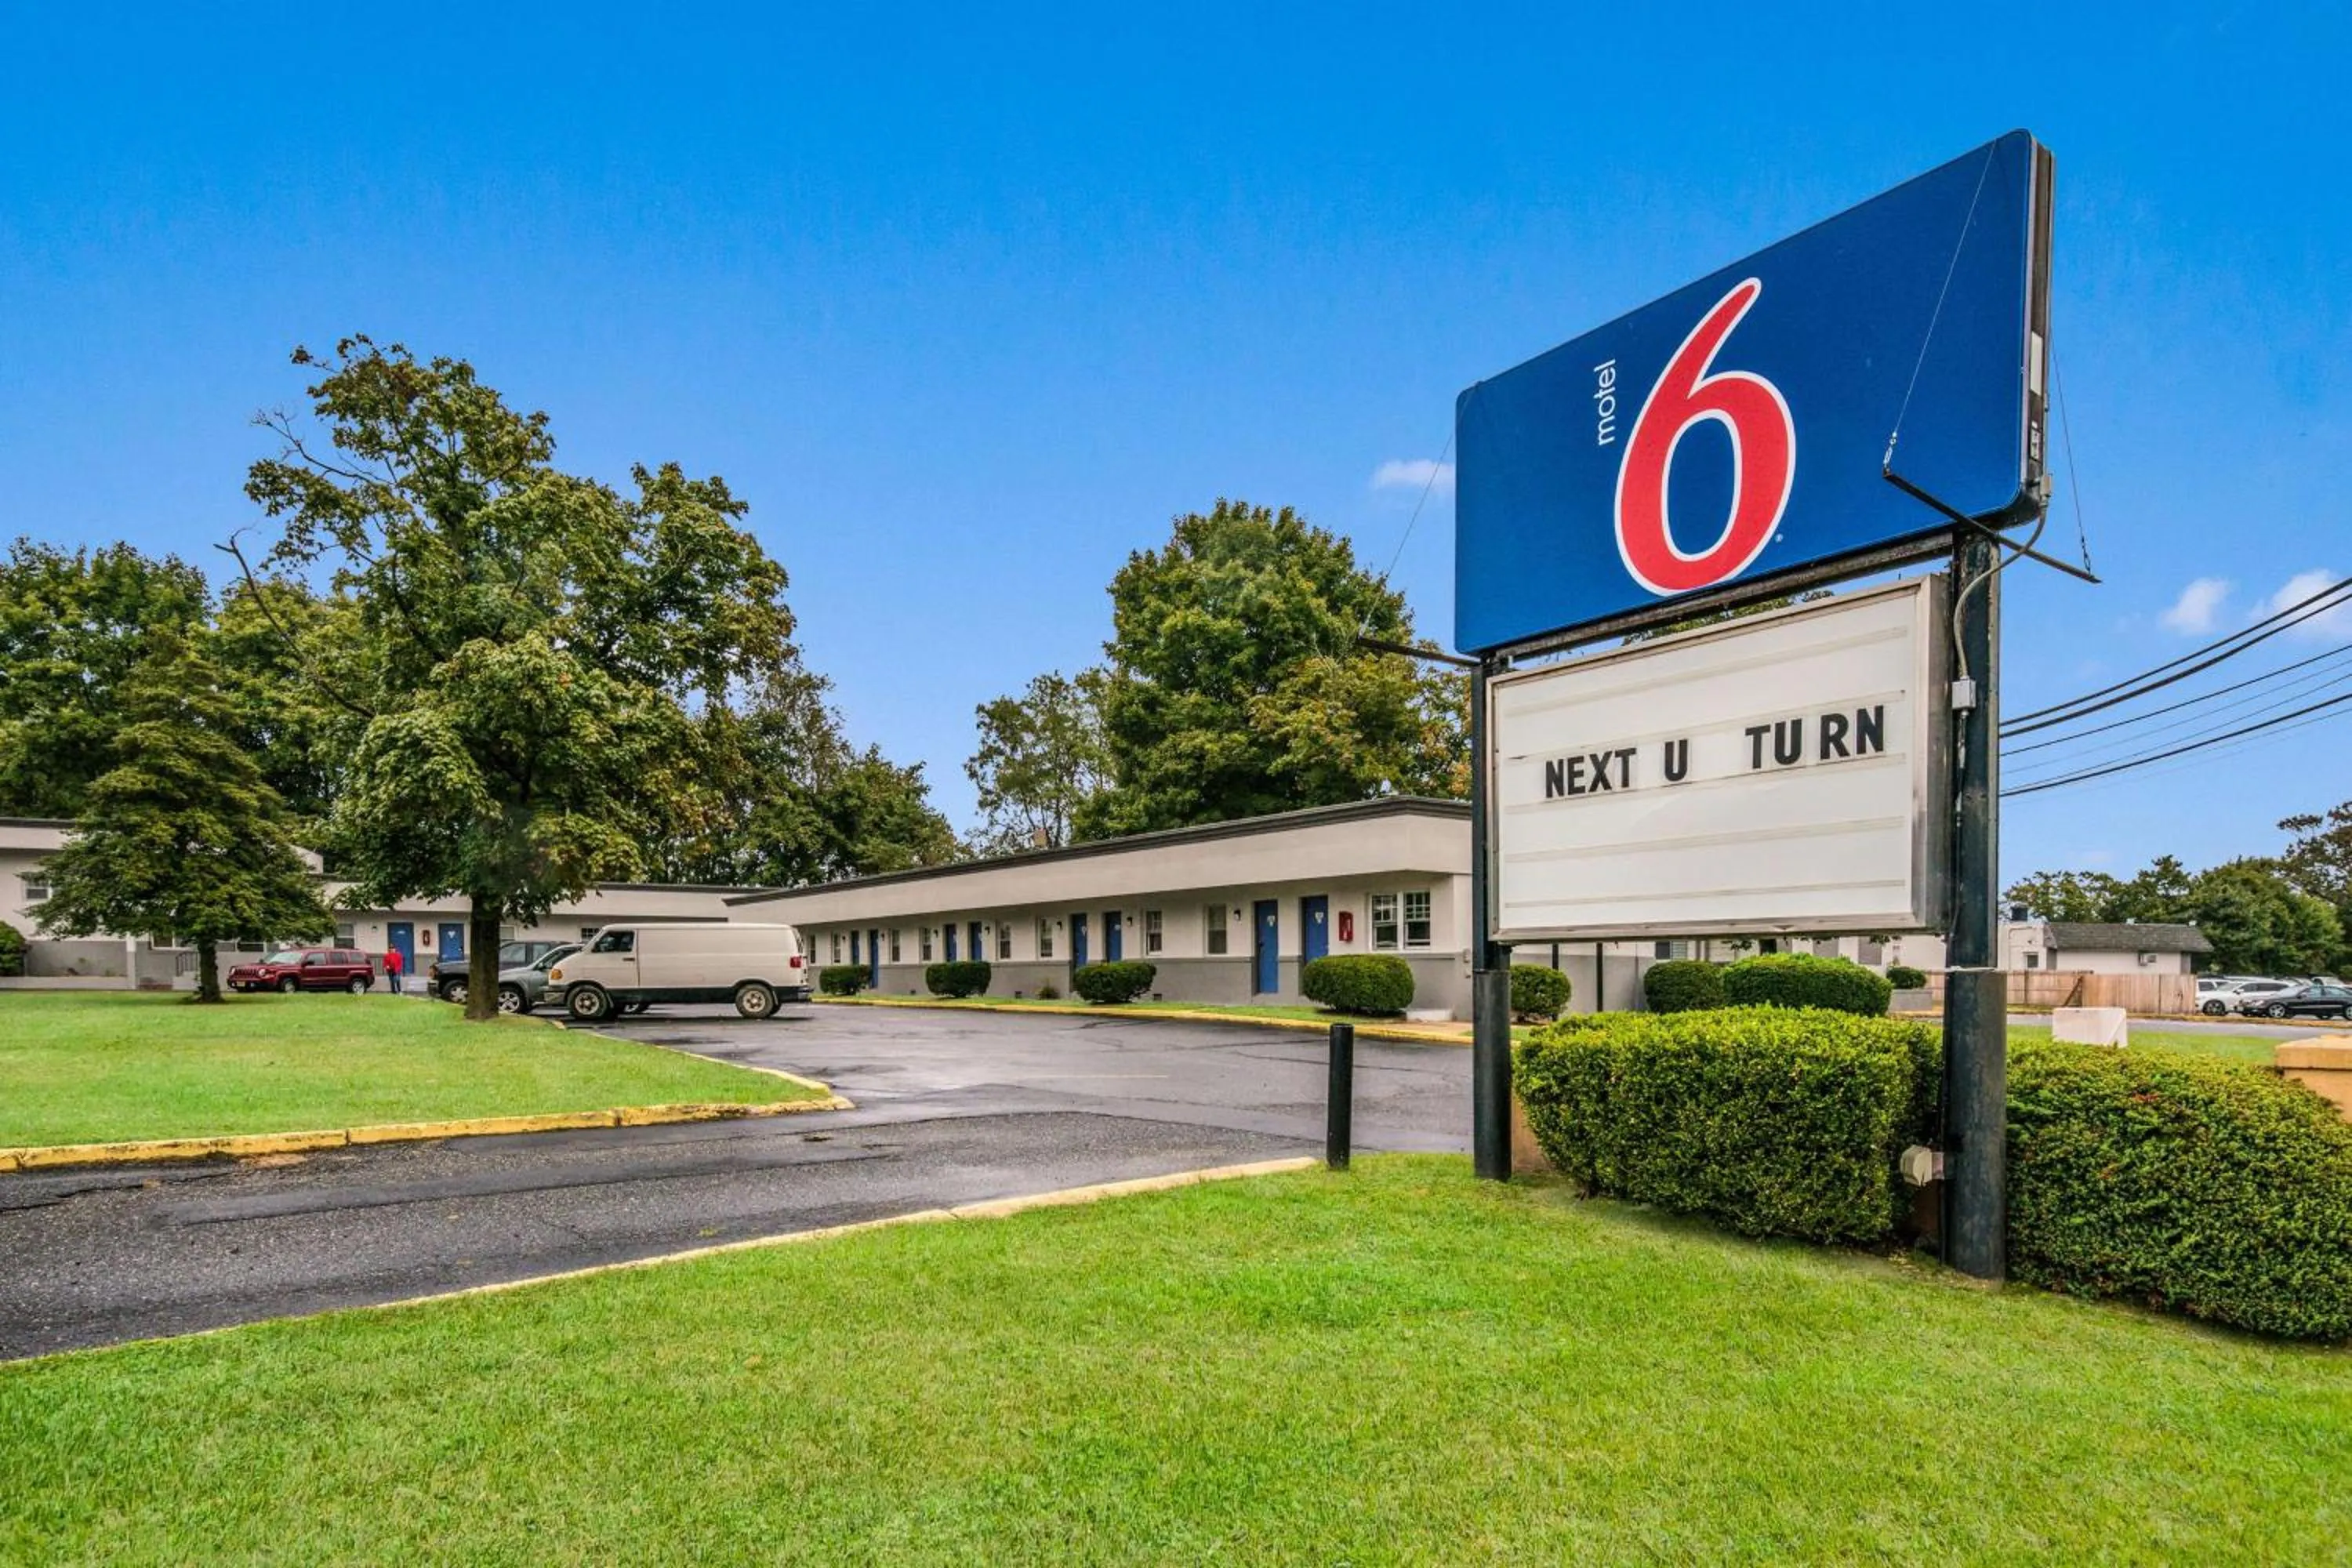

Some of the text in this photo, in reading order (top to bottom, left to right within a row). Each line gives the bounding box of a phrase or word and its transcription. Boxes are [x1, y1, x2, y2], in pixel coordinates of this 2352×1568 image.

[1594, 277, 1796, 597] motel 6
[1544, 704, 1884, 799] NEXT U TURN
